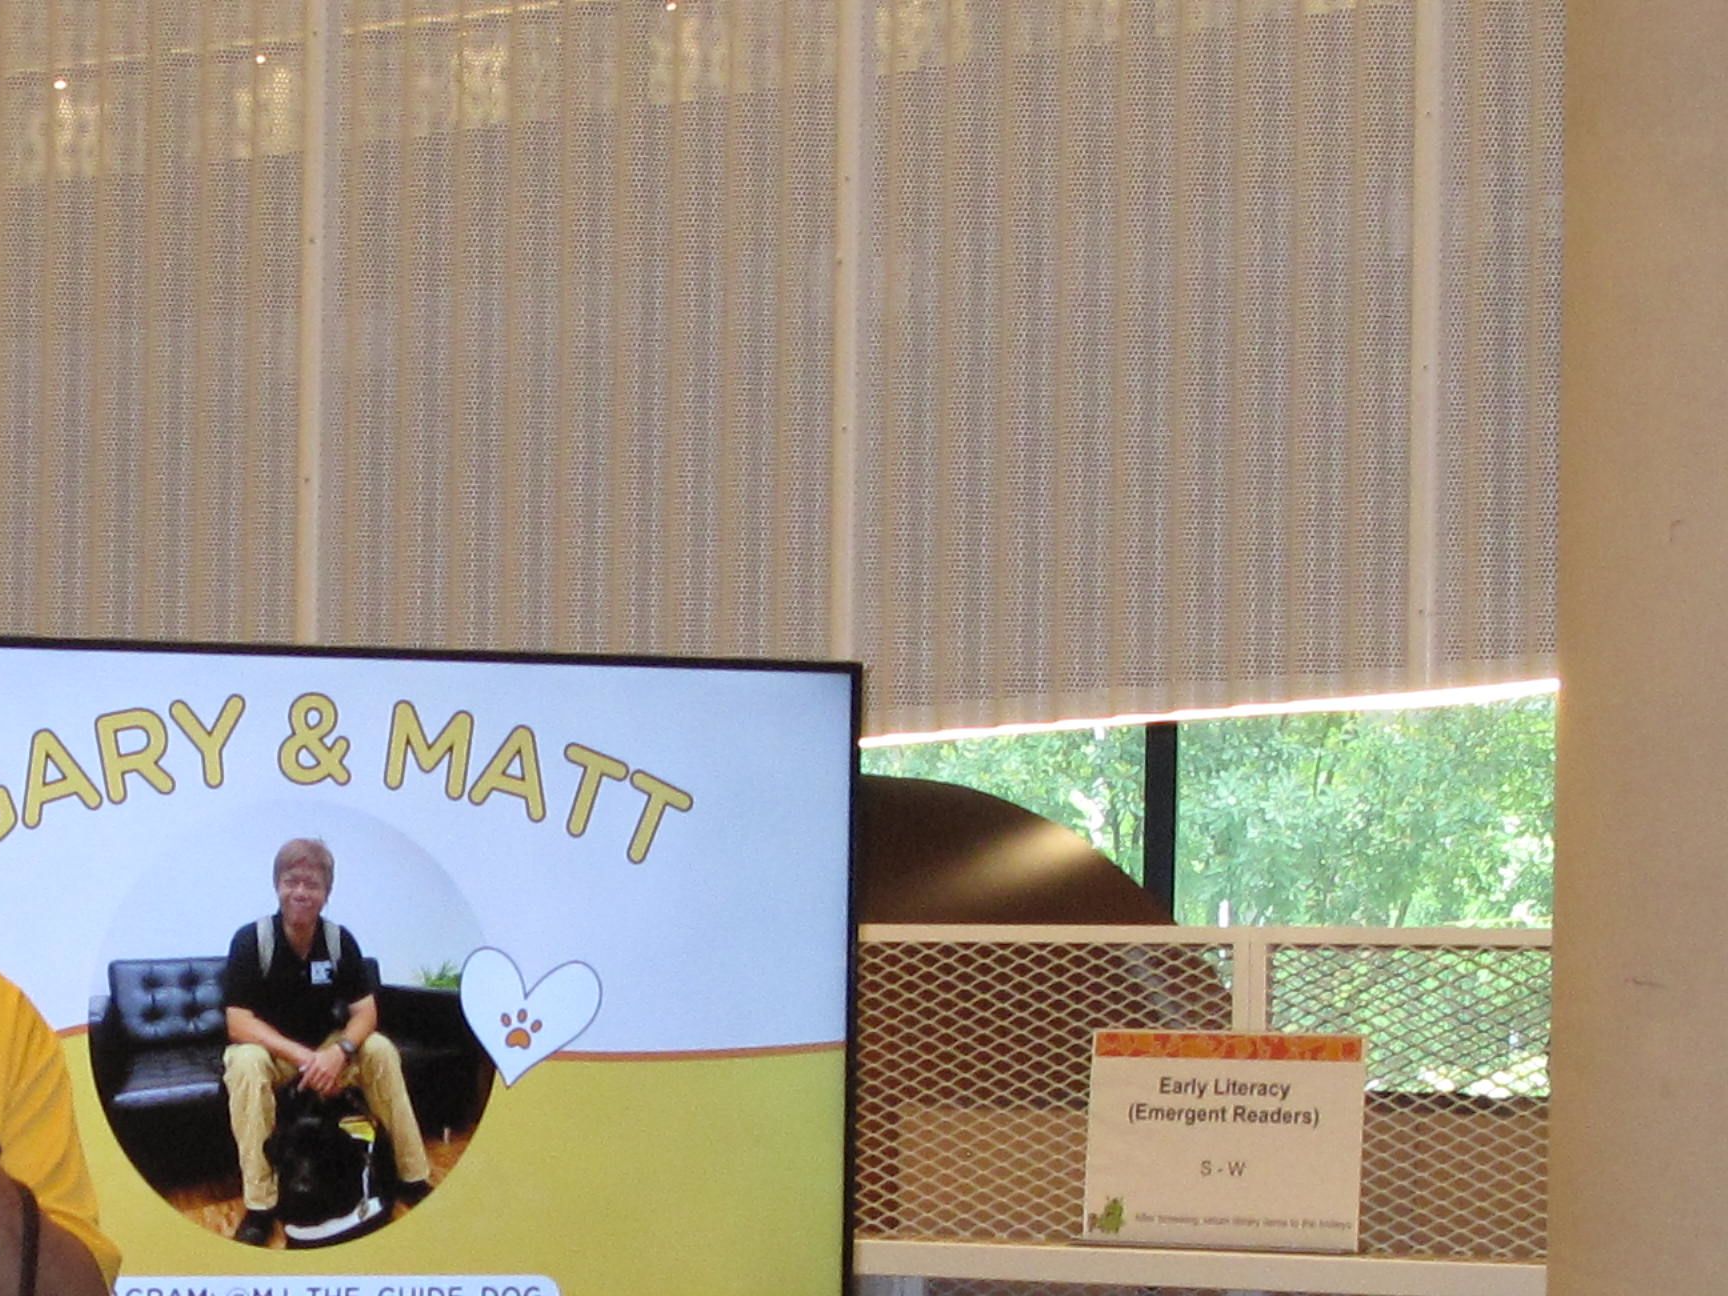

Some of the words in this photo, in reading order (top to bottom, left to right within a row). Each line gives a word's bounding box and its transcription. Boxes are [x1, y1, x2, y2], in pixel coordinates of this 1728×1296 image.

[277, 692, 352, 786] &
[383, 699, 694, 864] MATT
[1158, 1076, 1208, 1099] Early
[1213, 1078, 1291, 1101] Literacy
[1128, 1103, 1227, 1126] (Emergent
[1232, 1104, 1320, 1128] Readers)
[1199, 1160, 1212, 1177] S
[1227, 1160, 1247, 1177] W
